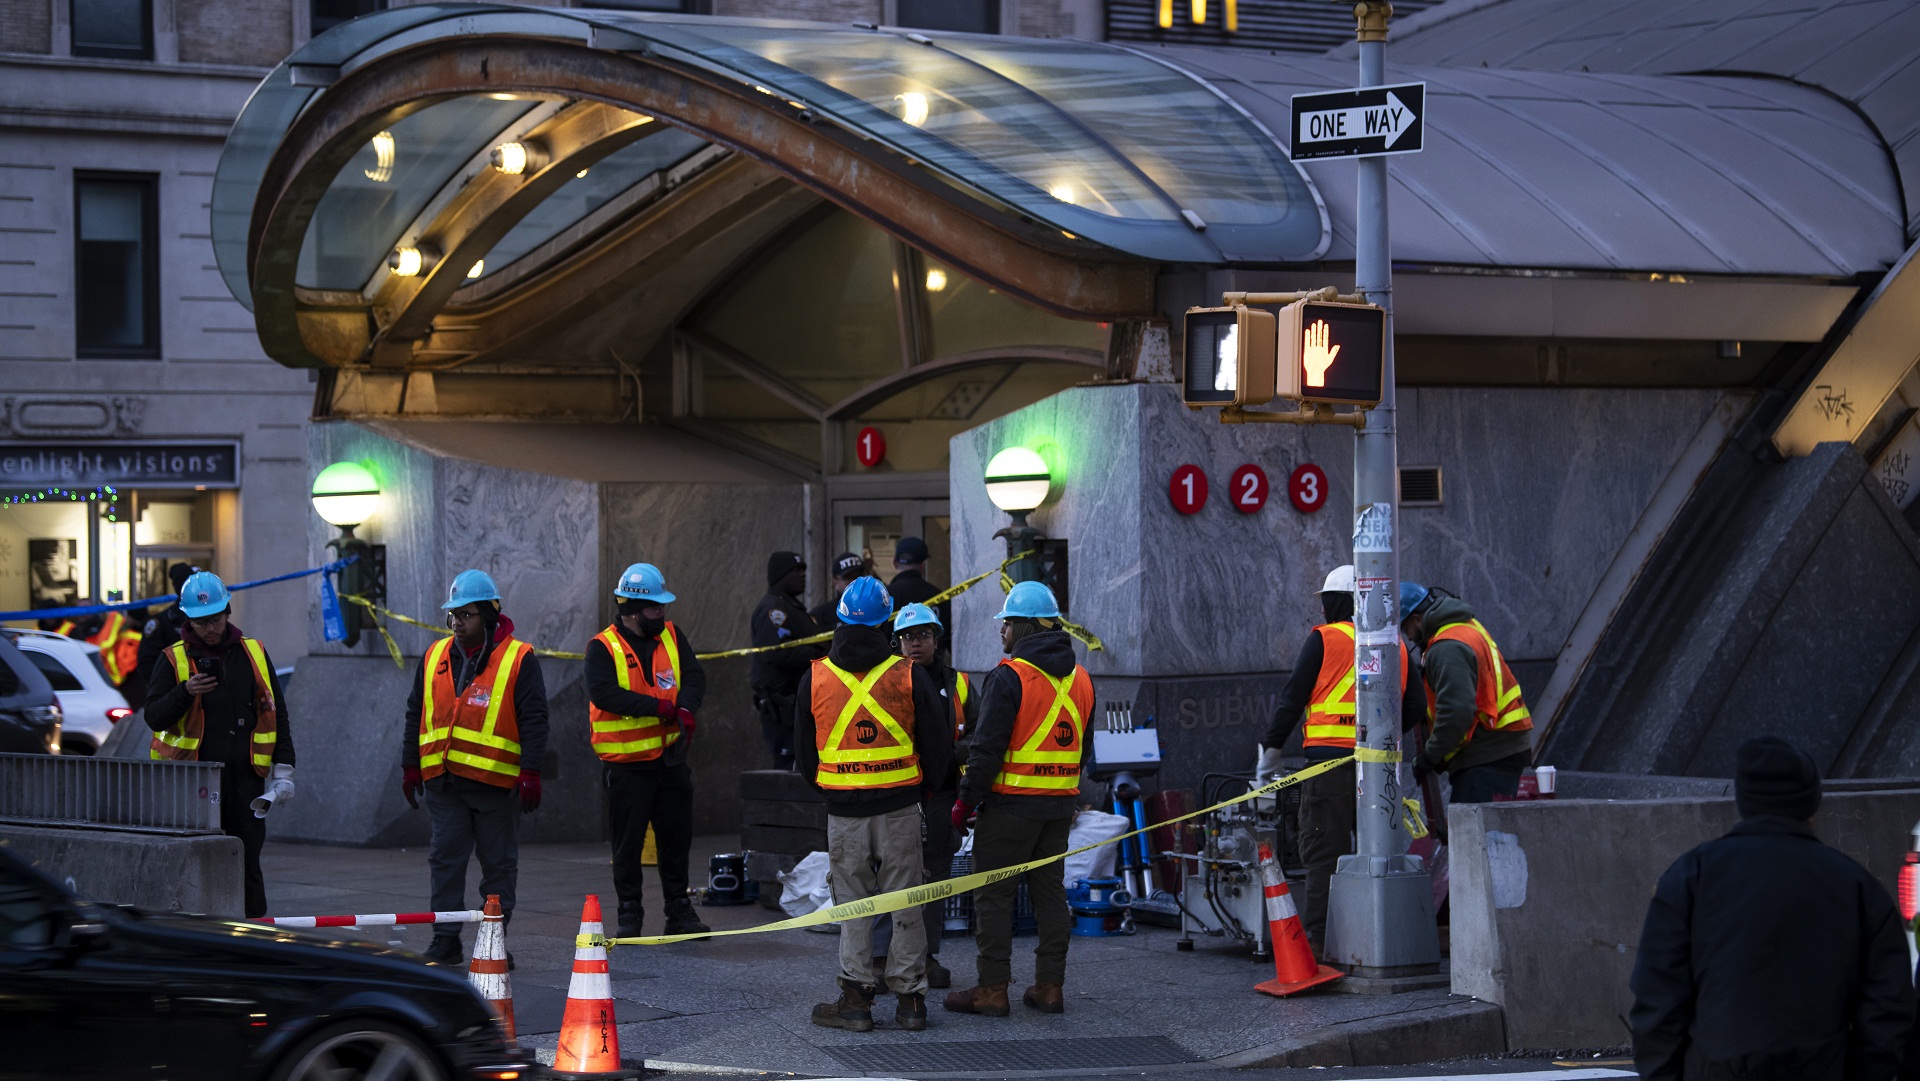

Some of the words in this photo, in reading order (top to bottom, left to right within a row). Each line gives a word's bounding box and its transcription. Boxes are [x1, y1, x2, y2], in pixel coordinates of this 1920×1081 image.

[1310, 113, 1347, 139] ONE
[1365, 107, 1404, 134] WAY
[862, 433, 872, 460] 1
[2, 450, 104, 479] enlight
[119, 450, 218, 474] visions
[1181, 473, 1194, 505] 1
[1241, 473, 1259, 504] 2
[1299, 472, 1318, 504] 3
[1178, 693, 1276, 730] SUBW
[1339, 715, 1356, 725] NY
[855, 724, 874, 740] MTA
[1056, 726, 1072, 740] MTA
[836, 762, 861, 774] NYC
[863, 758, 903, 773] Transit
[1033, 764, 1055, 775] NYC
[600, 1009, 609, 1054] NYCTA
